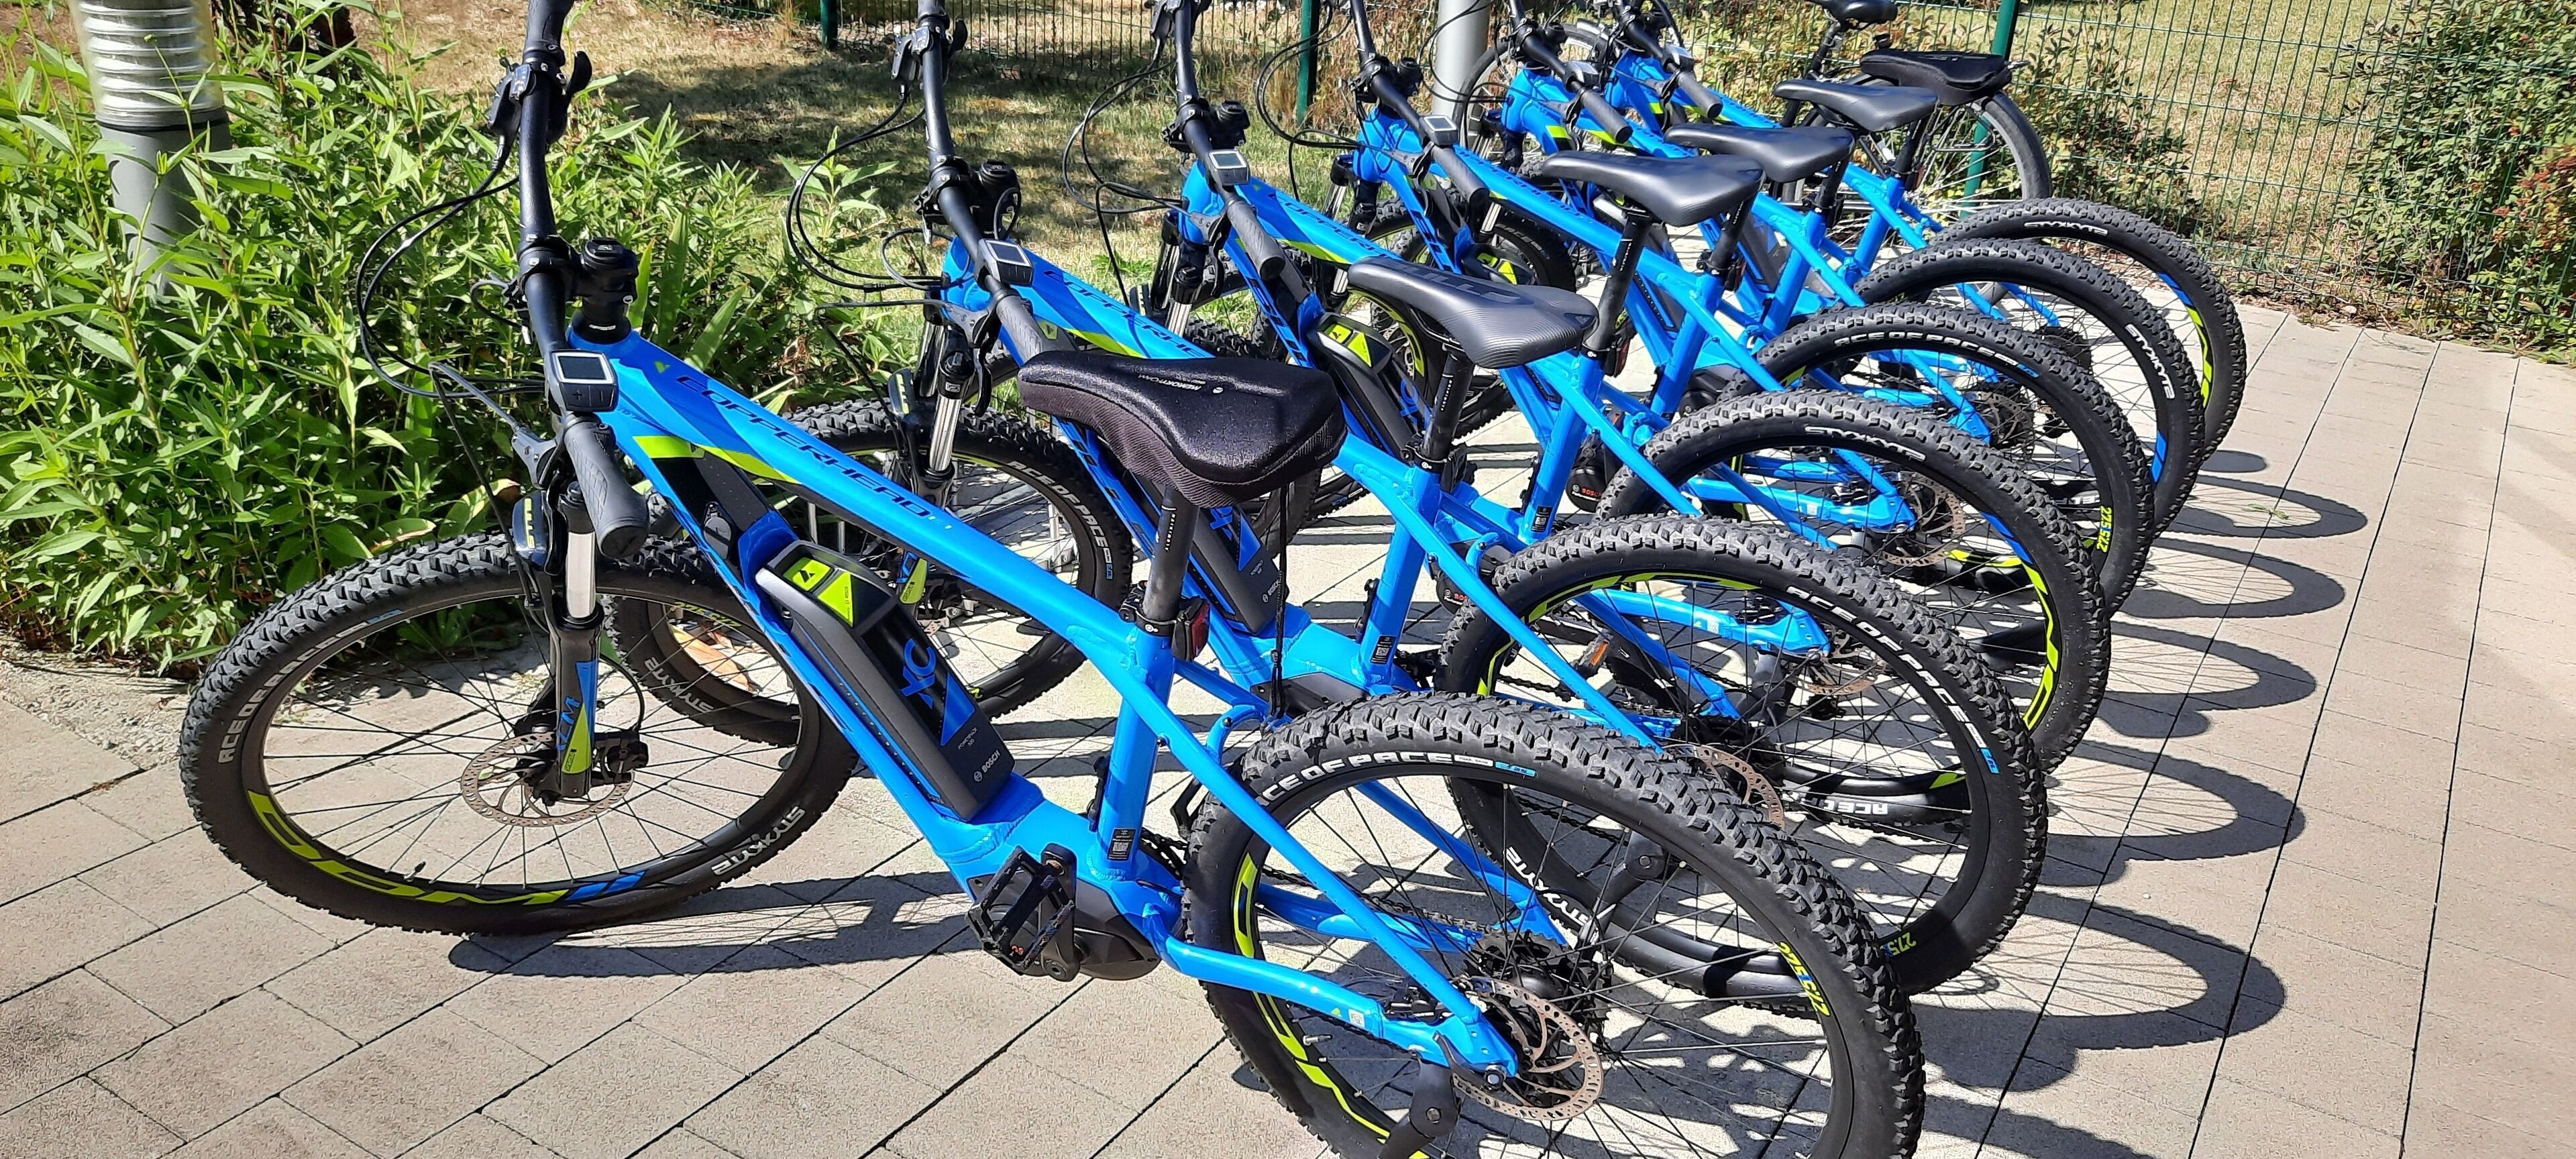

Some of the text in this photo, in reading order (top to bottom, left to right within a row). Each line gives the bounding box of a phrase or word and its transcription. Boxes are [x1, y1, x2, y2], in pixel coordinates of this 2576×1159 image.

[1044, 270, 1208, 357] COPPERHE
[1834, 331, 1884, 347] ACE
[1926, 334, 1996, 357] PACE
[676, 376, 930, 517] COPPERHEAD
[1008, 460, 1055, 488] ACE
[1076, 503, 1111, 549] PACE
[1786, 586, 1970, 724] ACE OF PACE
[218, 637, 337, 763] ACE OF PACE
[981, 749, 1002, 773] BOSCH
[1300, 759, 1345, 781] OF
[1348, 751, 1453, 768] PACE
